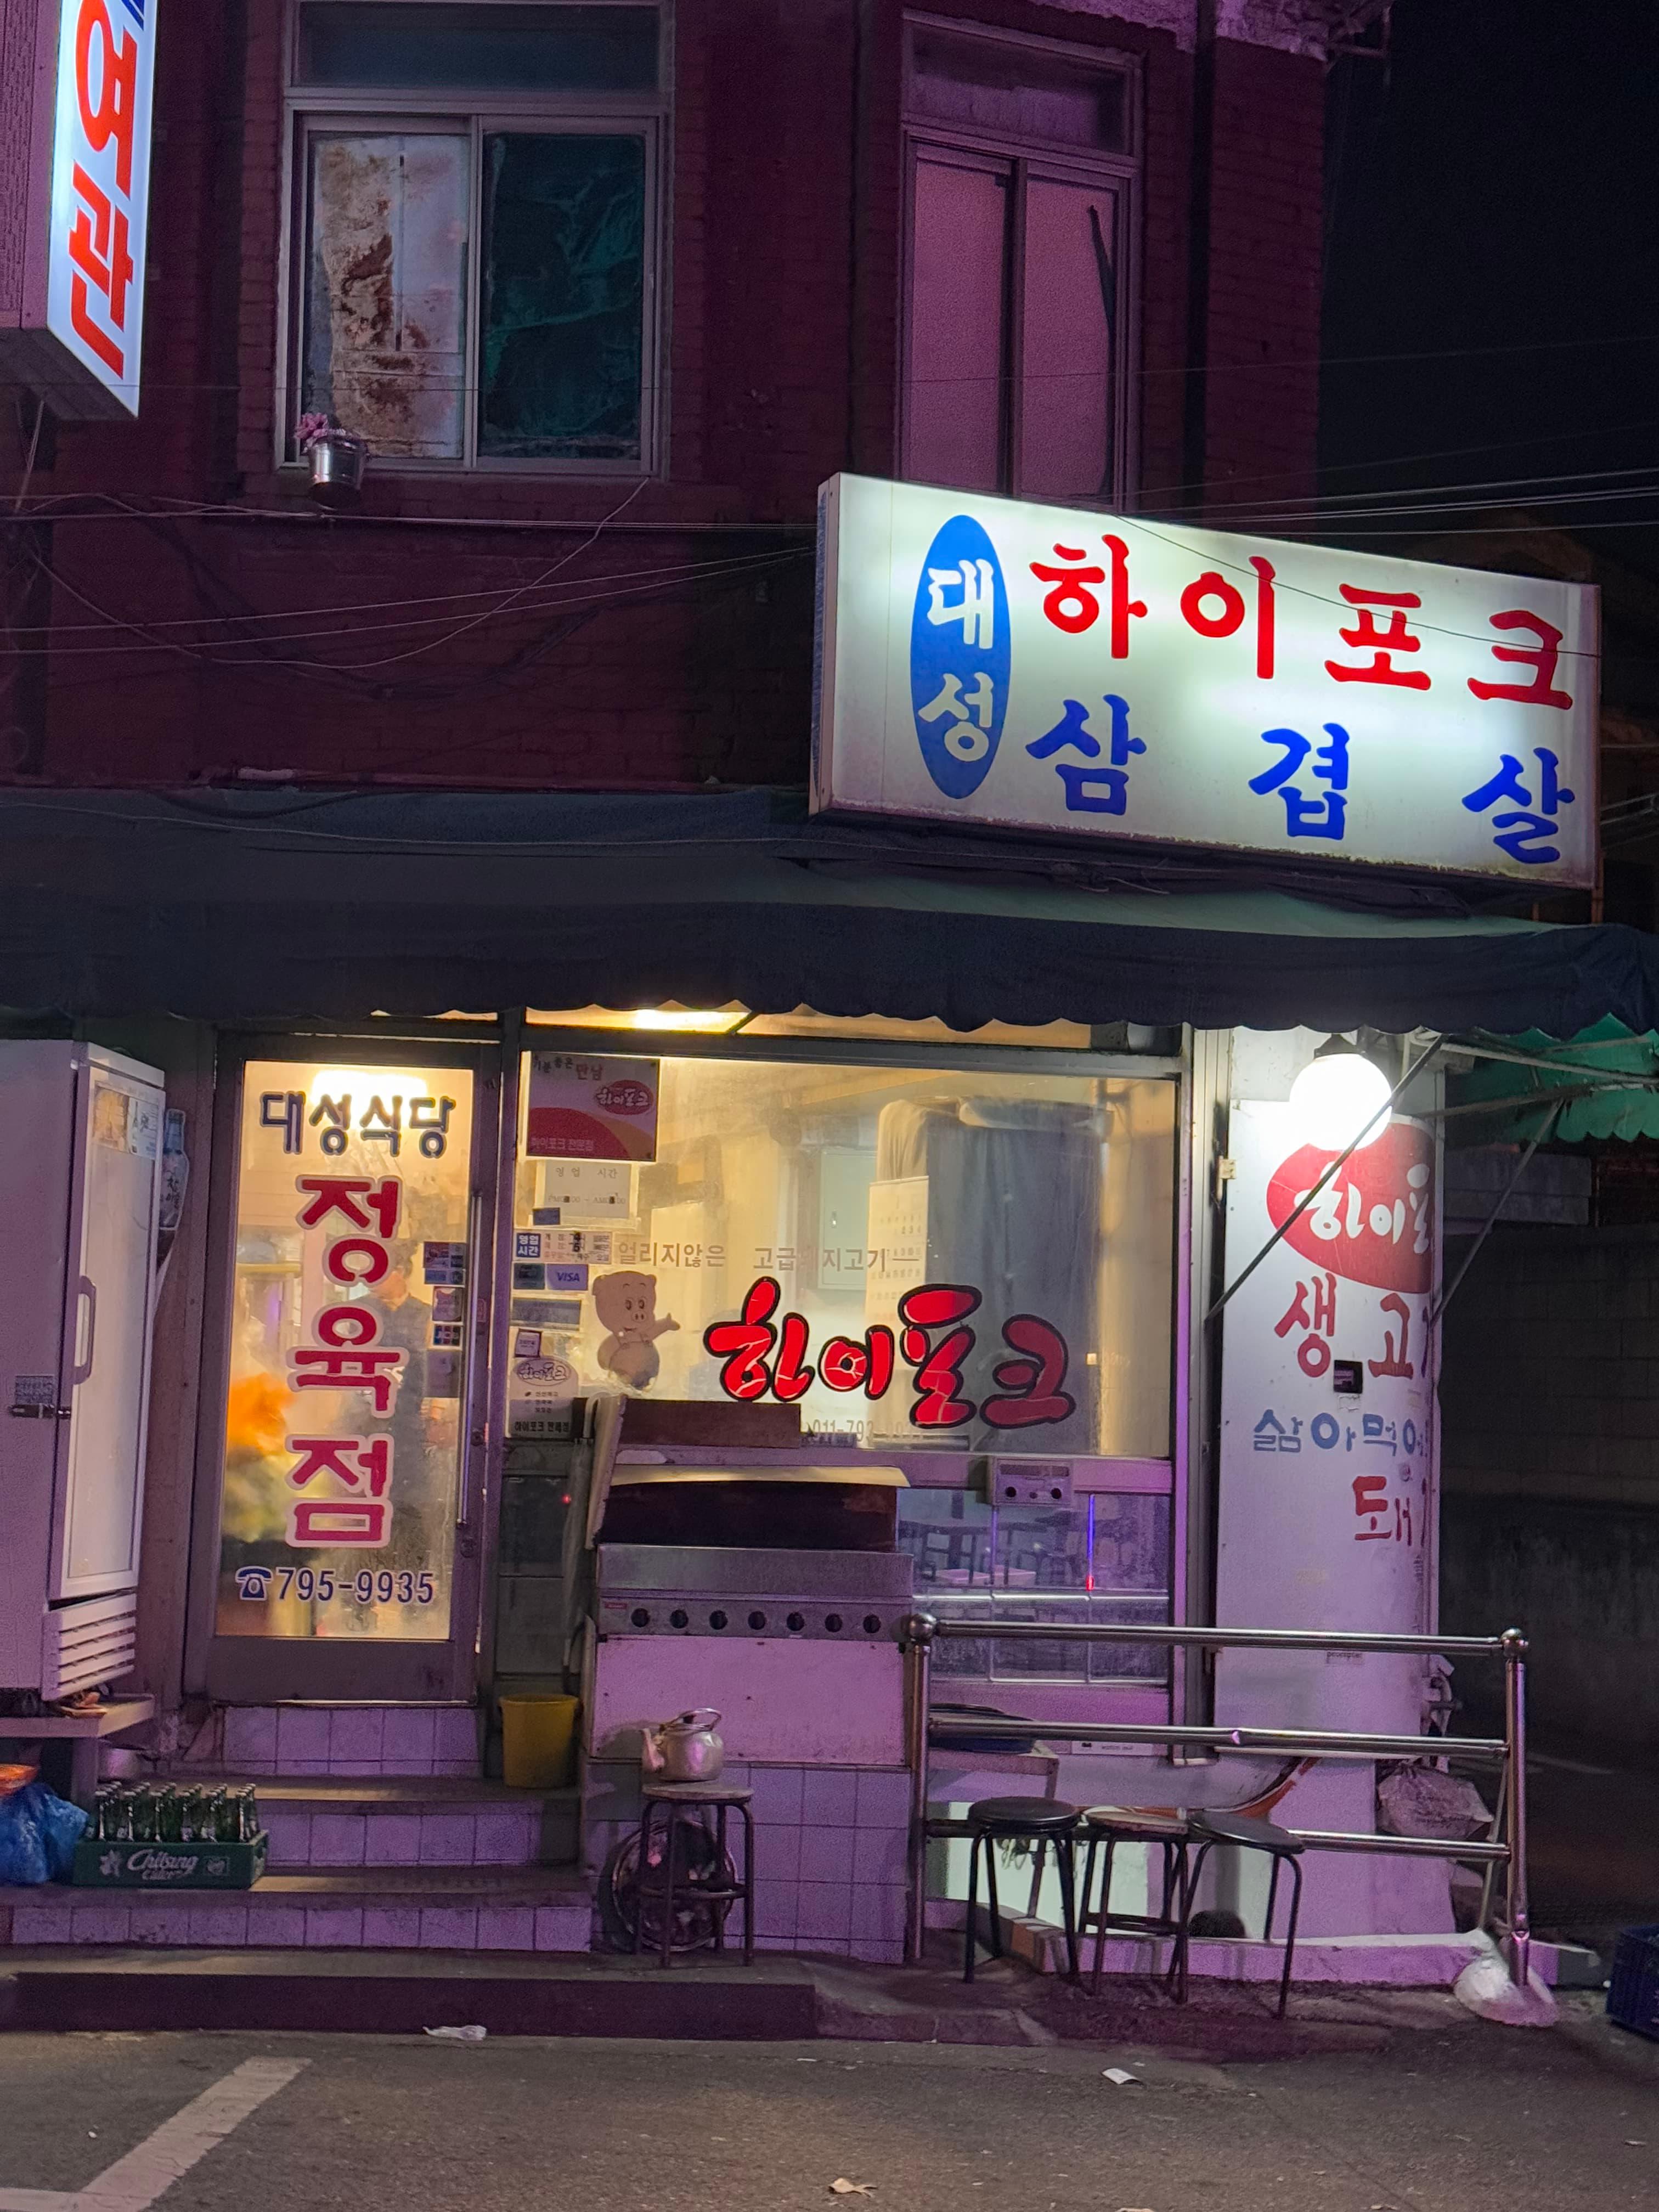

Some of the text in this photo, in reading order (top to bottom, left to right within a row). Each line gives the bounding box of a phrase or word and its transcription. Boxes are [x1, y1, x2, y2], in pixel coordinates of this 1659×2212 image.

[1029, 534, 1573, 710] 하이포크
[918, 558, 994, 762] 대성
[1025, 694, 1575, 864] 삼겹살
[575, 1062, 603, 1081] 만남
[595, 1086, 650, 1107] 하이포크
[260, 1091, 456, 1159] 대성식당
[597, 1167, 618, 1179] 시간
[518, 1245, 539, 1256] 시간
[519, 1234, 539, 1245] 영업
[618, 1242, 725, 1268] 얼리지않은
[753, 1246, 797, 1271] 고급
[556, 1272, 580, 1282] VISA
[286, 1176, 409, 1547] 정육점
[703, 1276, 1076, 1429] 하이포크
[275, 1567, 434, 1604] 795-9935
